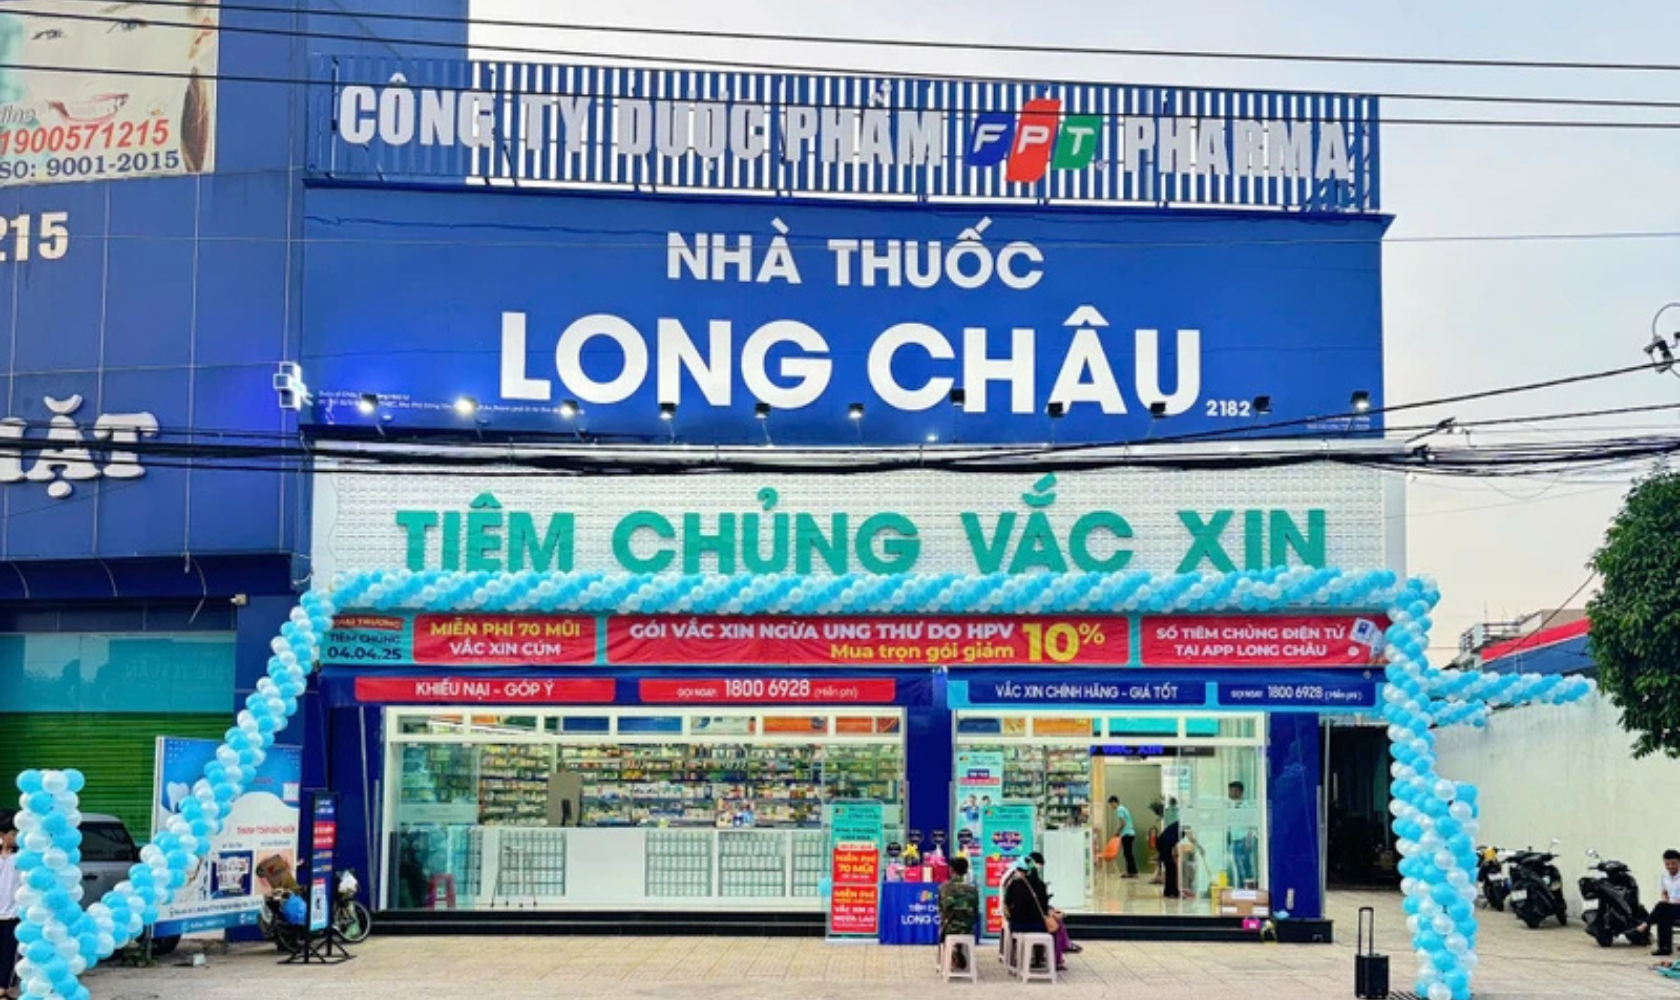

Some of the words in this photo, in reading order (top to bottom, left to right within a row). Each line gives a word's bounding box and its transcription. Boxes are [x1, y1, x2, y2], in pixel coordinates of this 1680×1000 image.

[339, 72, 494, 148] CÔNG
[520, 93, 592, 153] TY
[785, 82, 942, 166] PHẨM
[1123, 115, 1350, 180] PHARMA
[0, 119, 169, 154] 1900571215
[46, 150, 179, 176] 9001-2015
[667, 217, 802, 284] NHÀ
[827, 216, 1044, 289] THUỐC
[501, 311, 833, 409] LONG
[867, 305, 1200, 415] CHÂU
[1206, 400, 1250, 417] 2182
[396, 492, 574, 573] TIÊM
[611, 487, 921, 575] CHỦNG
[960, 472, 1134, 574] VẮC
[1175, 509, 1326, 574] XIN
[430, 618, 477, 637] MIỄN
[485, 619, 513, 637] PHÍ
[519, 622, 541, 637] 70
[545, 620, 581, 637] MŨI
[630, 620, 666, 639] GÓI
[672, 618, 715, 639] VẮC
[720, 623, 755, 639] XIN
[759, 621, 818, 640] NGỪA
[824, 624, 871, 639] UNG
[876, 621, 923, 639] THƯ
[928, 623, 962, 639] DO
[967, 624, 1014, 639] HPV
[1181, 626, 1219, 640] TIÊM
[1222, 624, 1278, 640] CHỦNG
[1282, 626, 1320, 643] ĐIỆN
[450, 639, 484, 656] VẮC
[489, 643, 518, 656] XIN
[522, 641, 561, 656] CÚM
[831, 645, 874, 659] Mua
[880, 646, 920, 662] trọn
[926, 642, 958, 662] gói
[963, 642, 1014, 662] giảm
[1022, 622, 1105, 662] 10%
[1174, 644, 1198, 660] TẠI
[1201, 645, 1234, 656] APP
[1237, 645, 1279, 656] LONG
[1283, 642, 1327, 656] CHÂU
[326, 646, 403, 660] 04.04.25
[415, 678, 460, 696] KHIẾU
[463, 681, 490, 700] NẠI
[504, 679, 540, 696] GÓP
[544, 678, 555, 696] Ý
[725, 679, 763, 697] 1800
[768, 679, 811, 697] 6928
[996, 680, 1021, 698] VẮC
[1024, 686, 1043, 698] XIN
[1045, 682, 1082, 698] CHÍNH
[1129, 683, 1152, 698] GIÁ
[1154, 682, 1178, 698] TỐT
[1268, 685, 1294, 698] 1800
[1295, 685, 1323, 699] 6928
